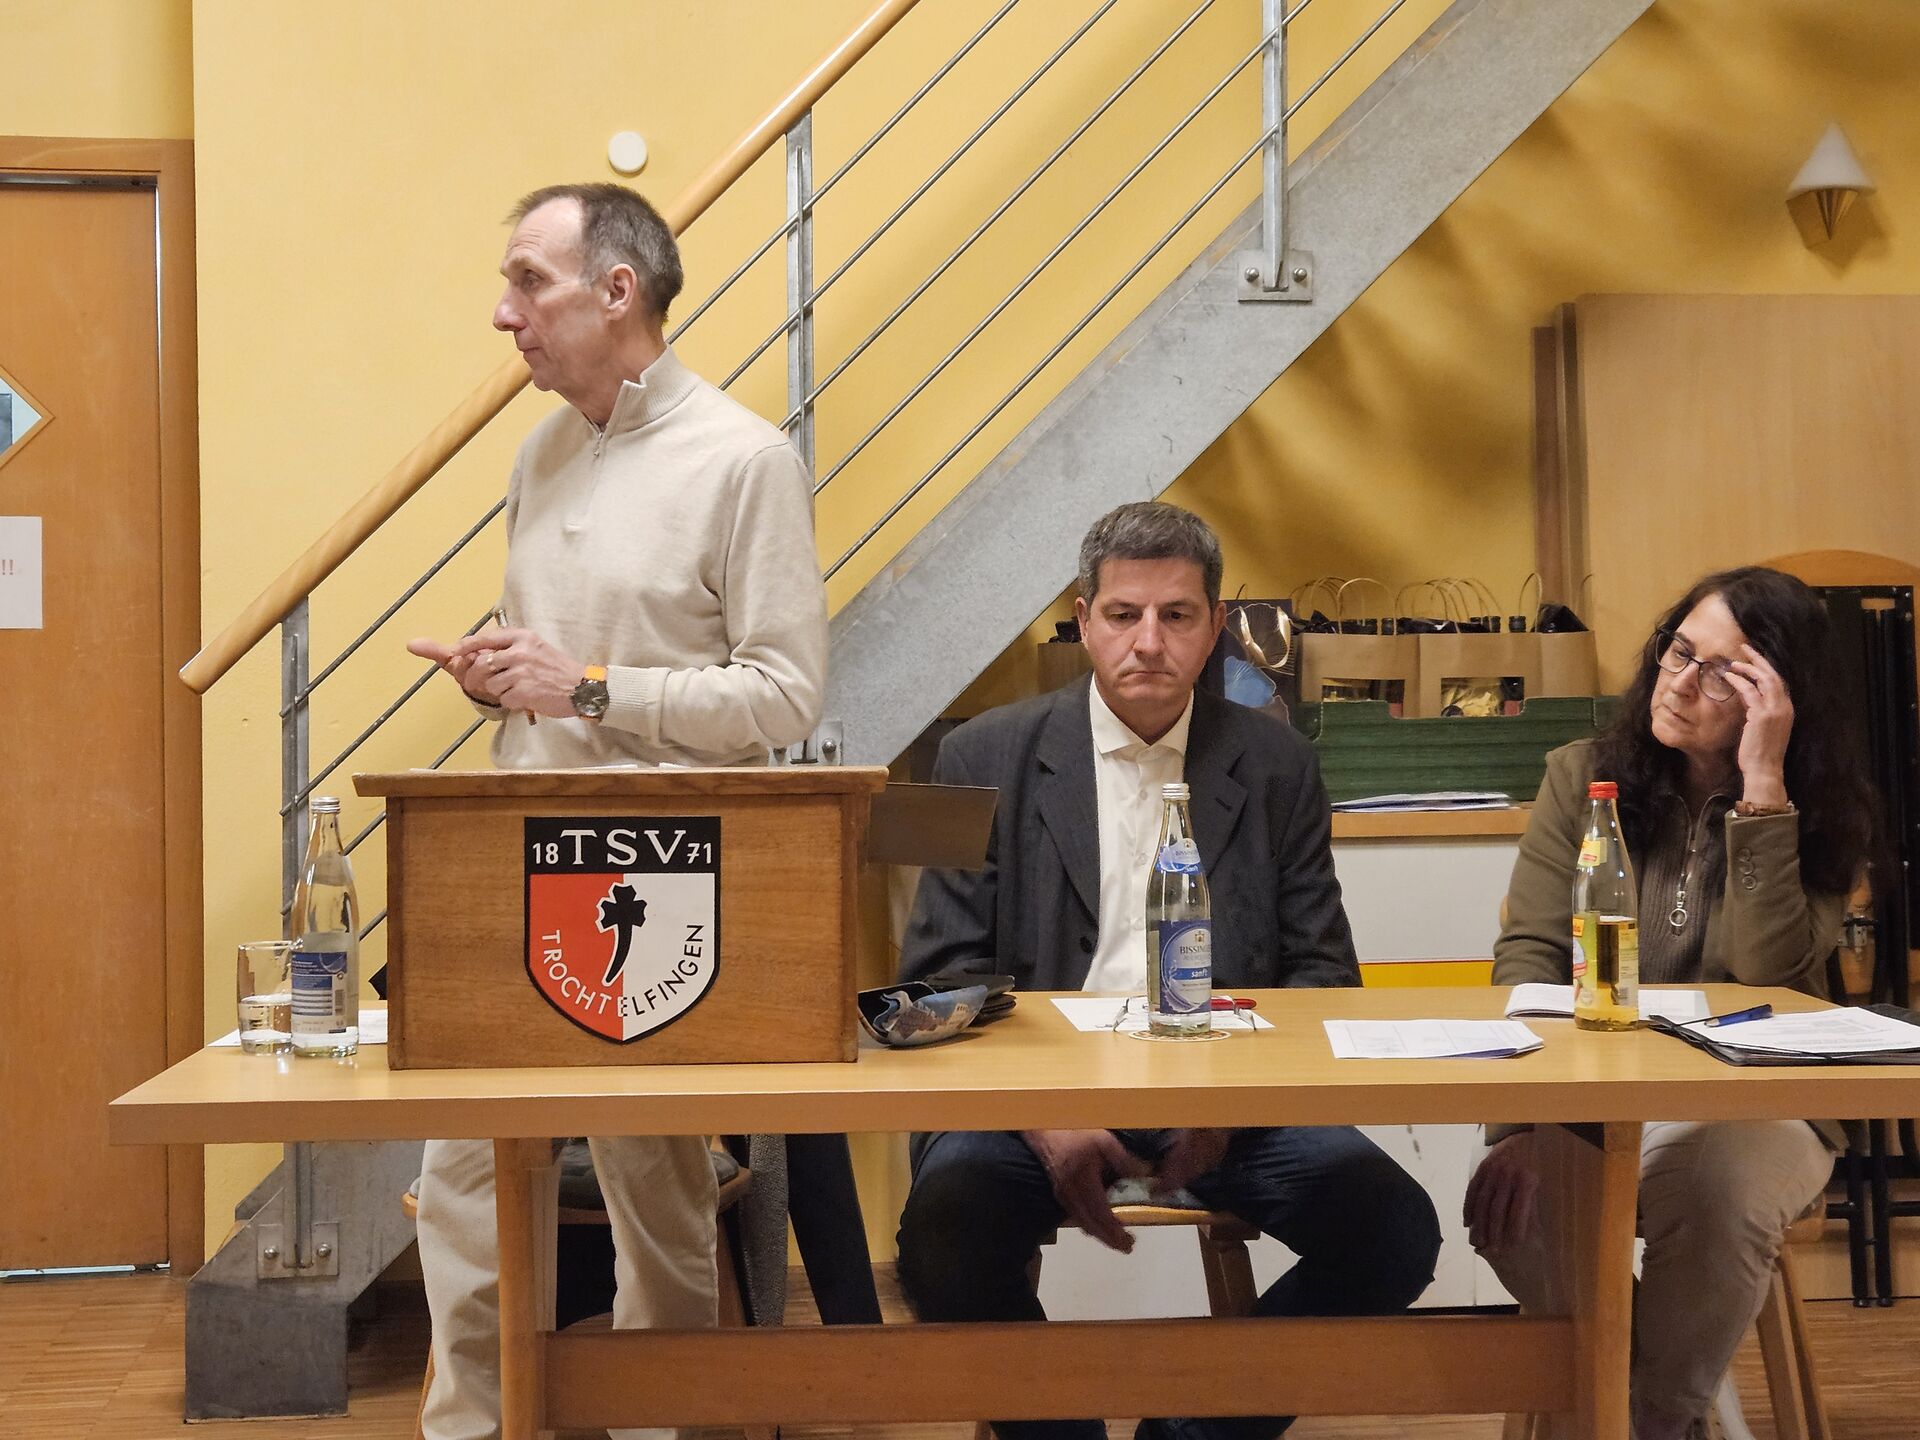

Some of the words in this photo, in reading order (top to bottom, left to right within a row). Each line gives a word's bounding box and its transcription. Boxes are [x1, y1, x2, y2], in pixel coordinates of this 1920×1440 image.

[532, 842, 559, 865] 18
[560, 829, 686, 866] TSV
[687, 843, 712, 864] 71
[541, 924, 704, 1017] TROCHTELFINGEN
[1191, 968, 1208, 978] sanft
